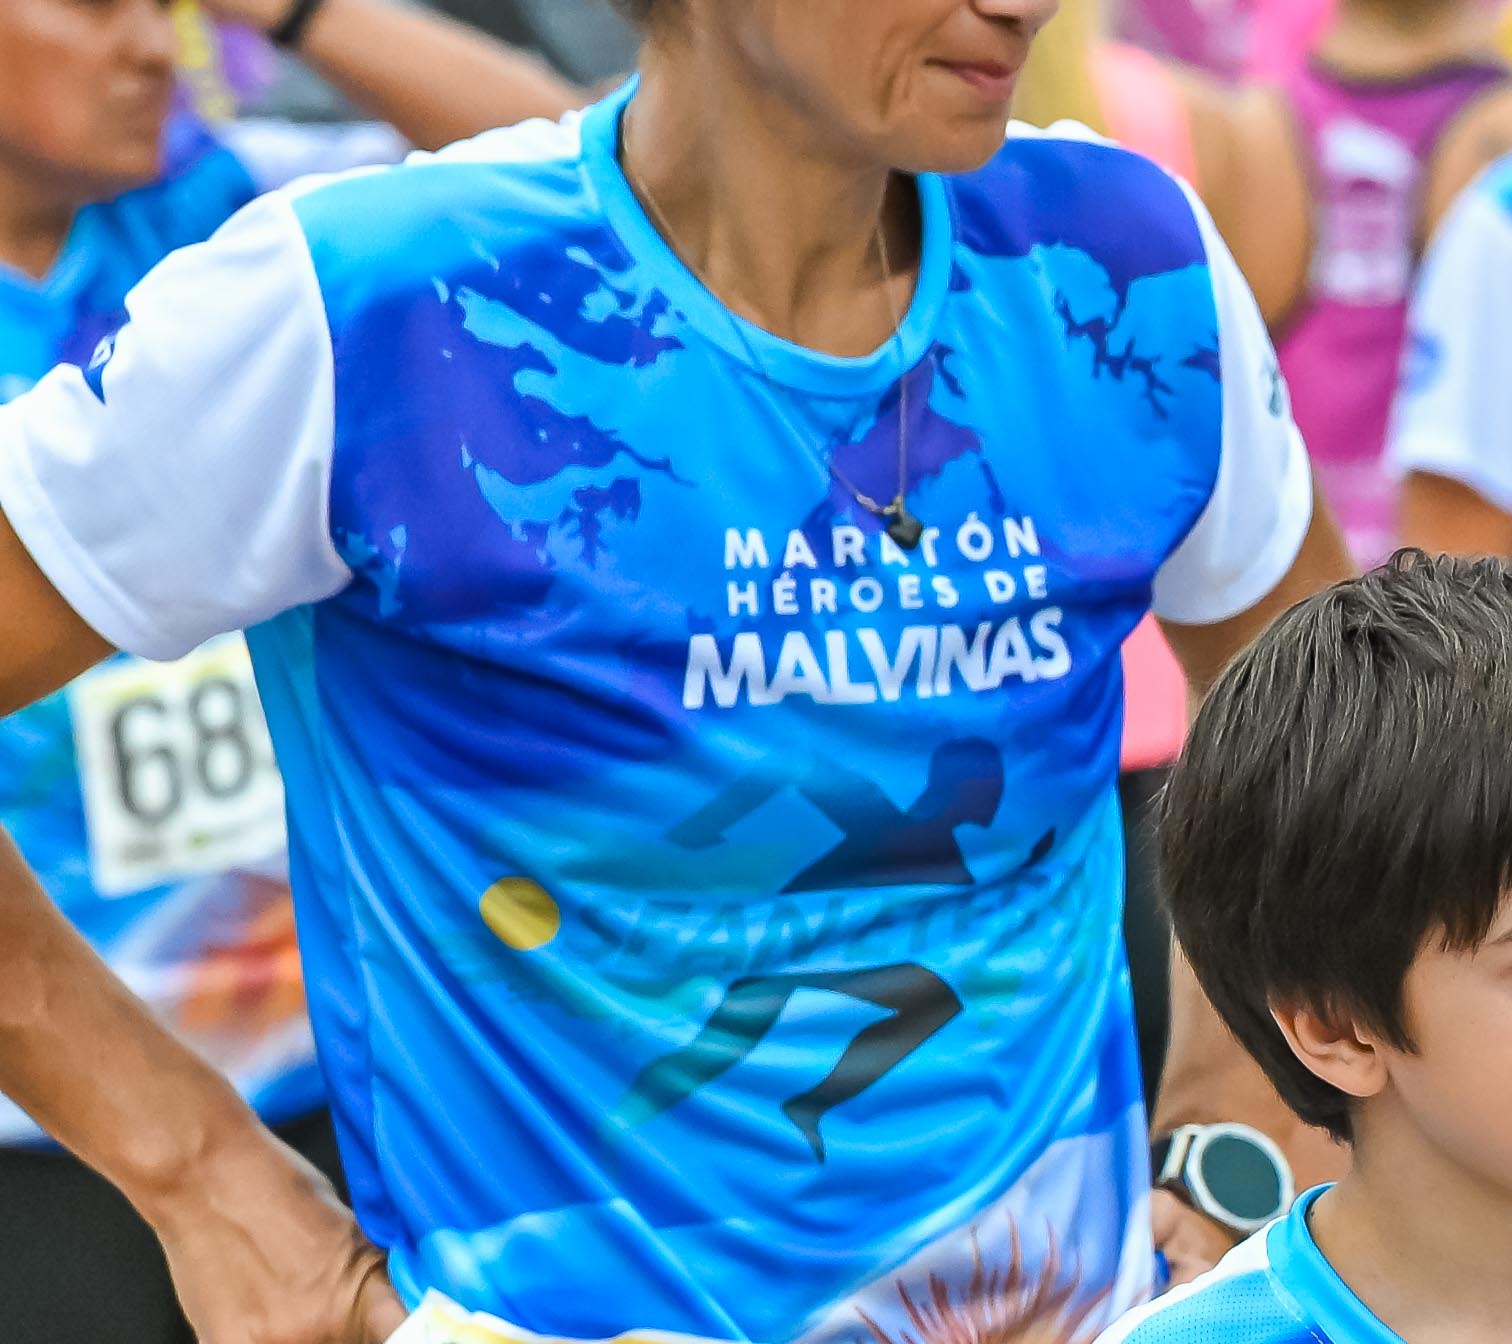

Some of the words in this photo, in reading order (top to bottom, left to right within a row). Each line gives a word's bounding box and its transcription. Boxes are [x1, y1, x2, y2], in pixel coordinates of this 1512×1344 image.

[725, 513, 1042, 569] MARATÓN
[728, 572, 960, 617] HÉROES
[984, 564, 1048, 604] DE
[682, 606, 1072, 710] MALVINAS
[110, 677, 256, 826] 68
